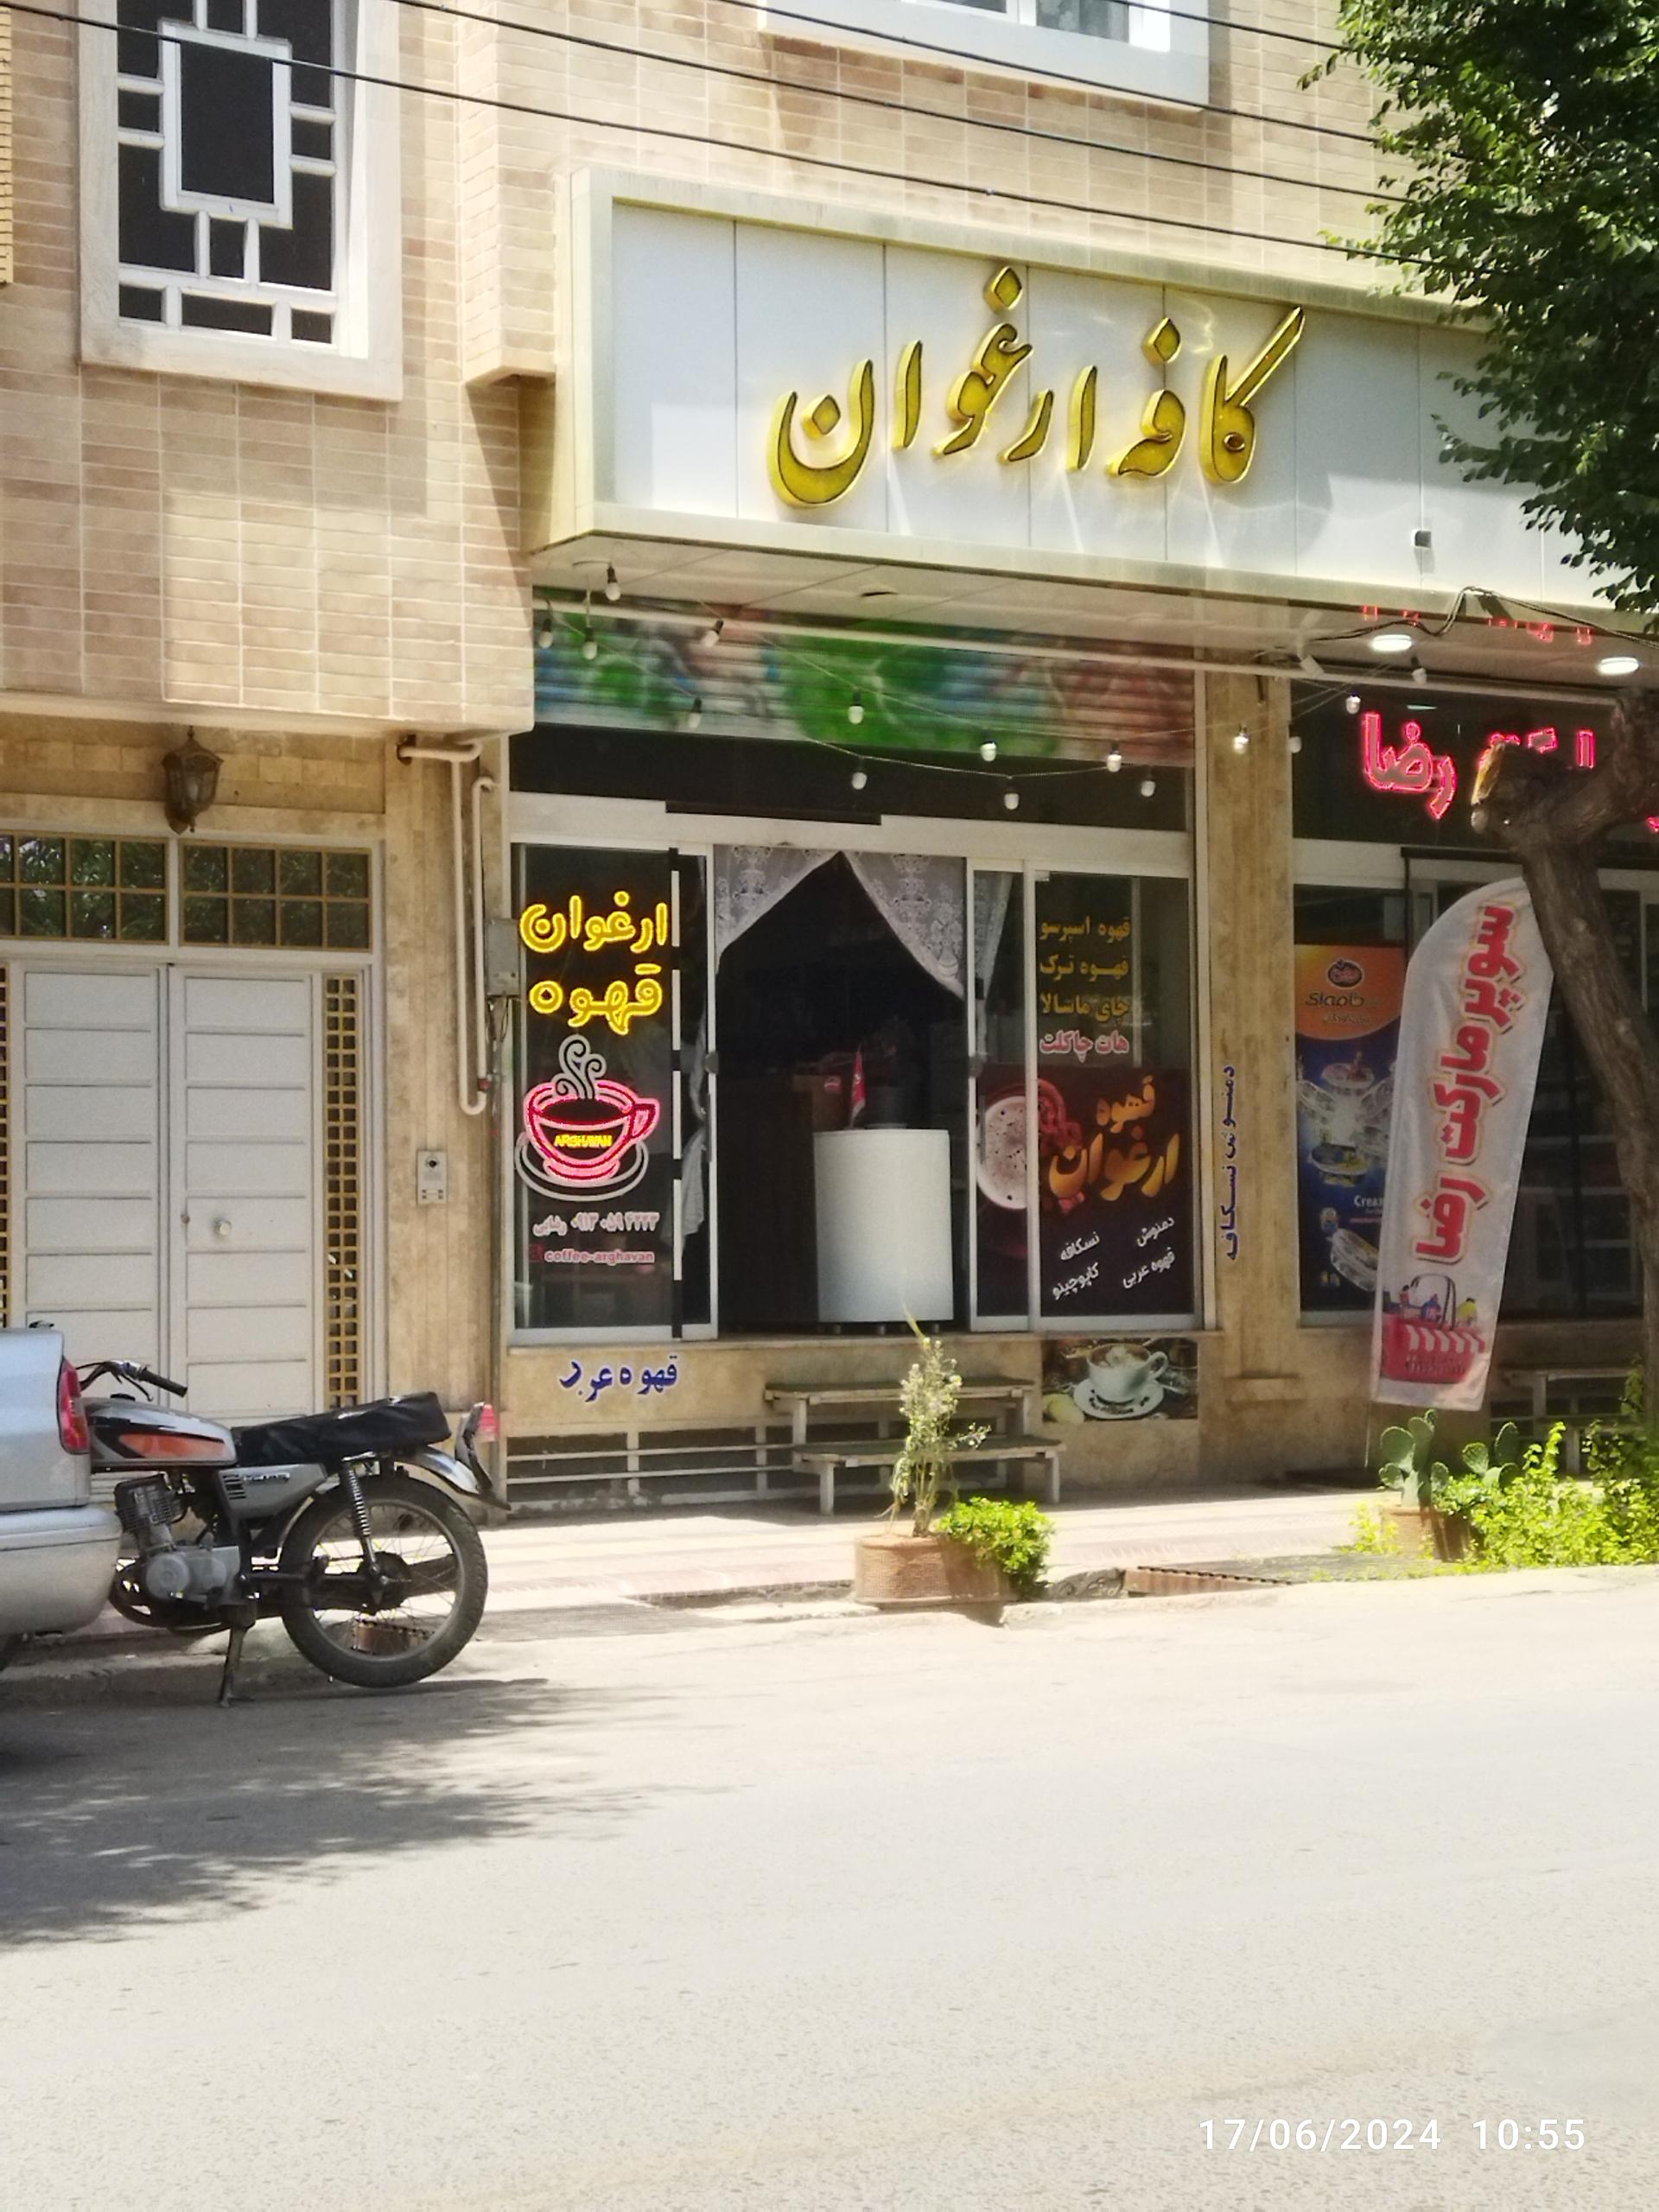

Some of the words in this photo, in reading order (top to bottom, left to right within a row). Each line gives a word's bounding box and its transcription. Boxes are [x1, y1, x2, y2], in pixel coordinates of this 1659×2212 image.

[768, 265, 1097, 507] ارغوان
[1105, 307, 1305, 483] کافه
[1364, 712, 1457, 819] رضا
[520, 891, 668, 953] ارغوان
[1039, 916, 1090, 944] اسپرسو
[1098, 917, 1131, 944] قهوه
[1039, 954, 1074, 981] ترک
[1080, 955, 1129, 982] قهوه
[530, 963, 662, 1035] قهوه
[1040, 993, 1090, 1015] ماسالا
[1095, 995, 1130, 1023] چای
[1039, 1029, 1094, 1064] چاکلت
[1095, 1030, 1130, 1053] هات
[1096, 1075, 1155, 1134] قهوه
[1049, 1125, 1180, 1202] ارغوان
[1220, 1166, 1238, 1261] نسکافه
[1415, 1176, 1488, 1262] رضا
[1060, 1231, 1100, 1261] نسکافه
[1052, 1262, 1099, 1300] کاپوچینو
[1123, 1265, 1149, 1288] عربی
[620, 1355, 678, 1395] قهوه
